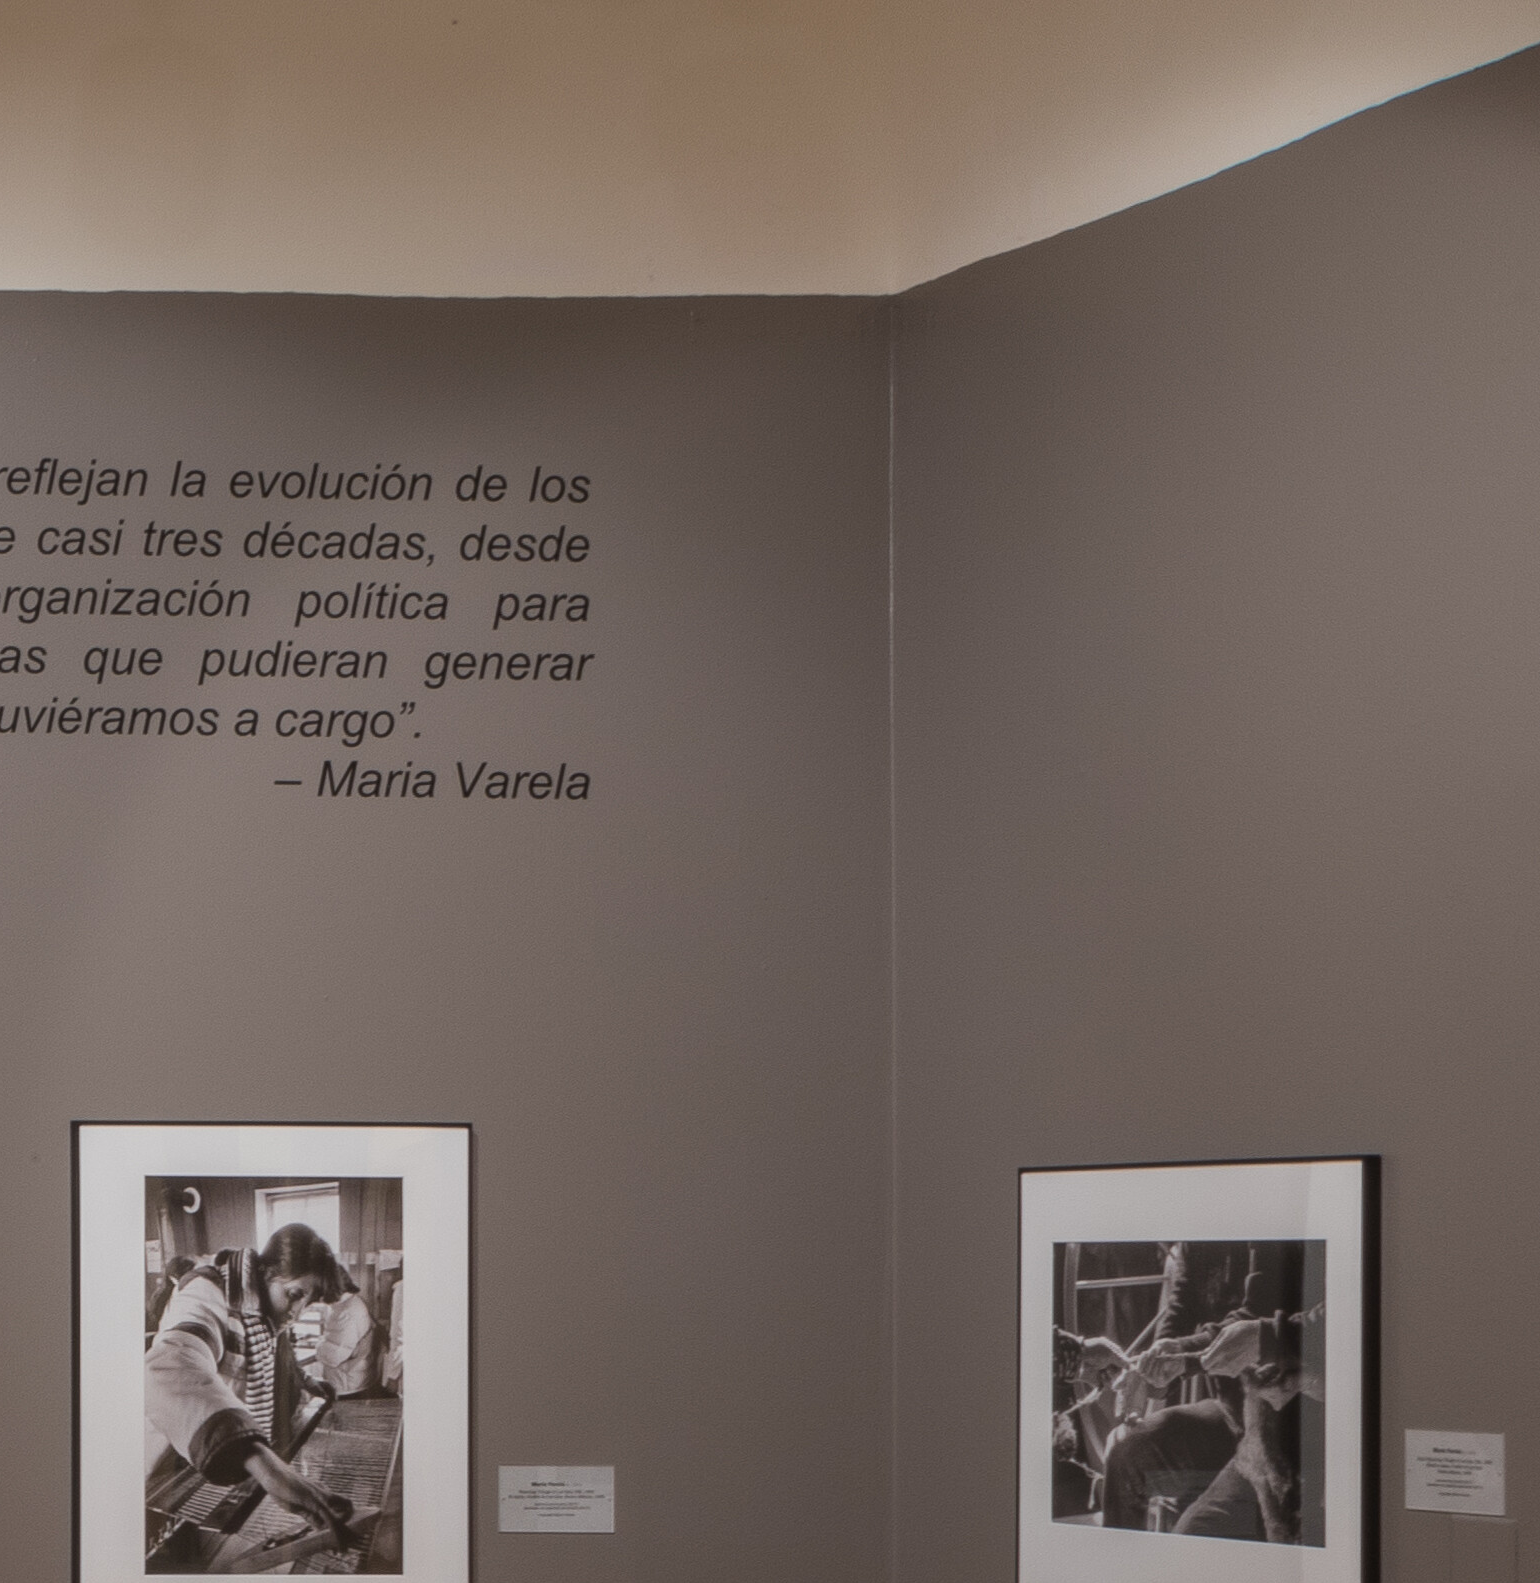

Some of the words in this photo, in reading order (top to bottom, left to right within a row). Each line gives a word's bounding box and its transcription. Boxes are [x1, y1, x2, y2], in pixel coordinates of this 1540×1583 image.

[168, 459, 208, 499] la
[228, 461, 434, 503] evolución
[454, 463, 509, 504] de
[527, 464, 592, 505] los
[35, 517, 124, 558] casi
[142, 519, 225, 559] tres
[242, 519, 436, 569] décadas,
[458, 522, 592, 564] desde
[292, 580, 451, 629] política
[491, 592, 592, 632] para
[82, 645, 165, 686] que
[196, 638, 389, 688] pudieran
[422, 650, 597, 691] generar
[232, 707, 260, 738] a
[274, 700, 422, 749] cargo”.
[316, 758, 438, 800] Maria
[454, 760, 592, 802] Varela
